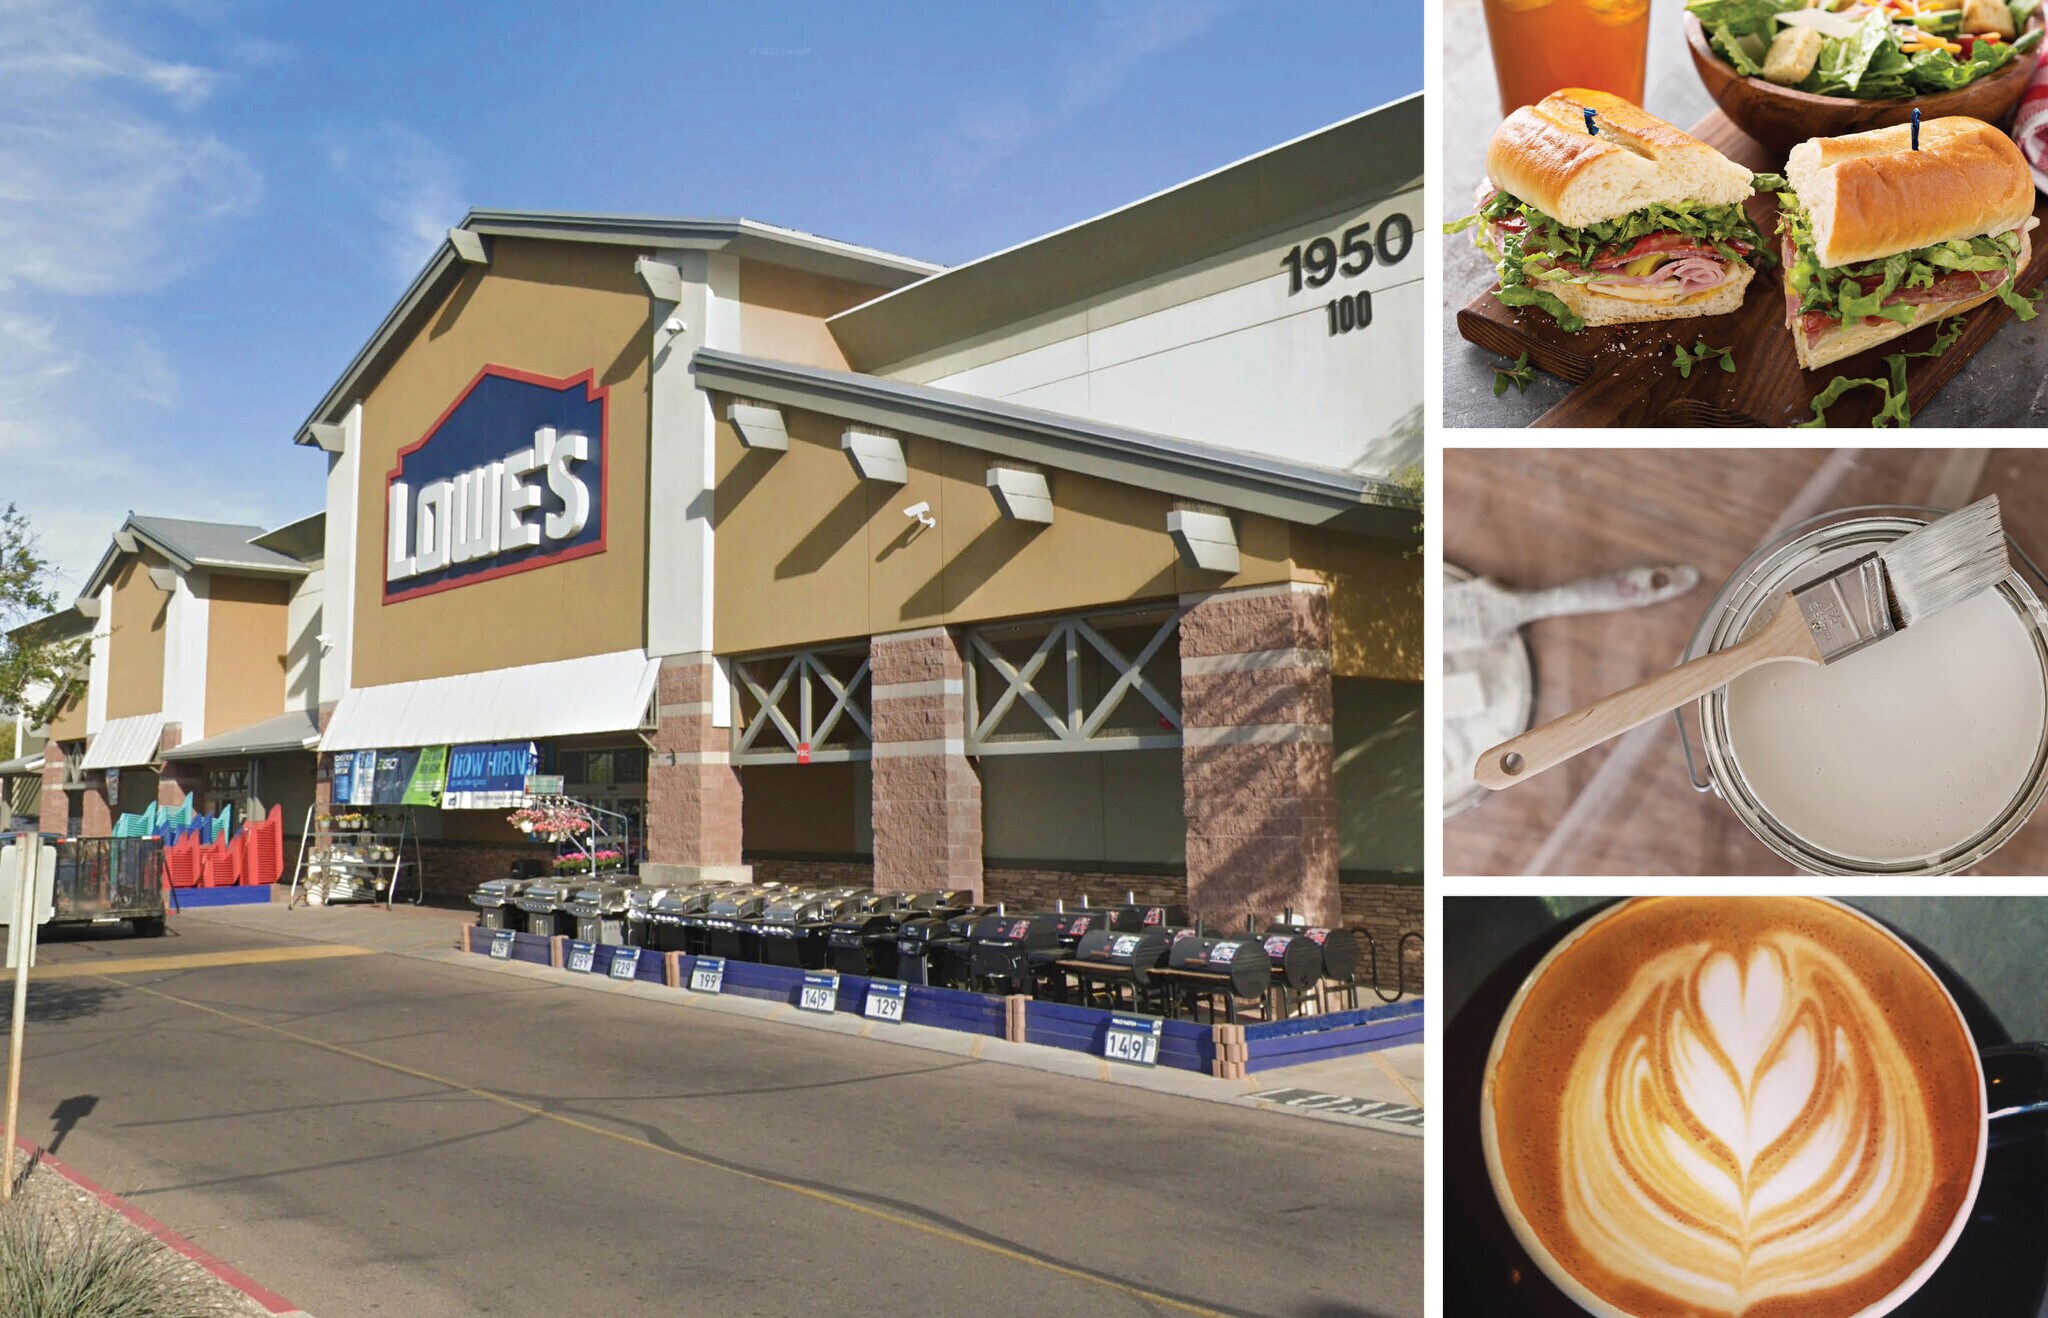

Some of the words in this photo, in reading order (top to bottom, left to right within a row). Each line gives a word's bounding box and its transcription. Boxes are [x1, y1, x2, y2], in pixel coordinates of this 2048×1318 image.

[1281, 212, 1414, 296] 1950
[1326, 290, 1373, 336] 100
[387, 427, 590, 581] LOWE'S
[453, 751, 487, 778] NOW
[700, 973, 717, 988] 199
[805, 989, 828, 1007] 149
[877, 998, 897, 1016] 129
[1110, 1034, 1142, 1059] 149
